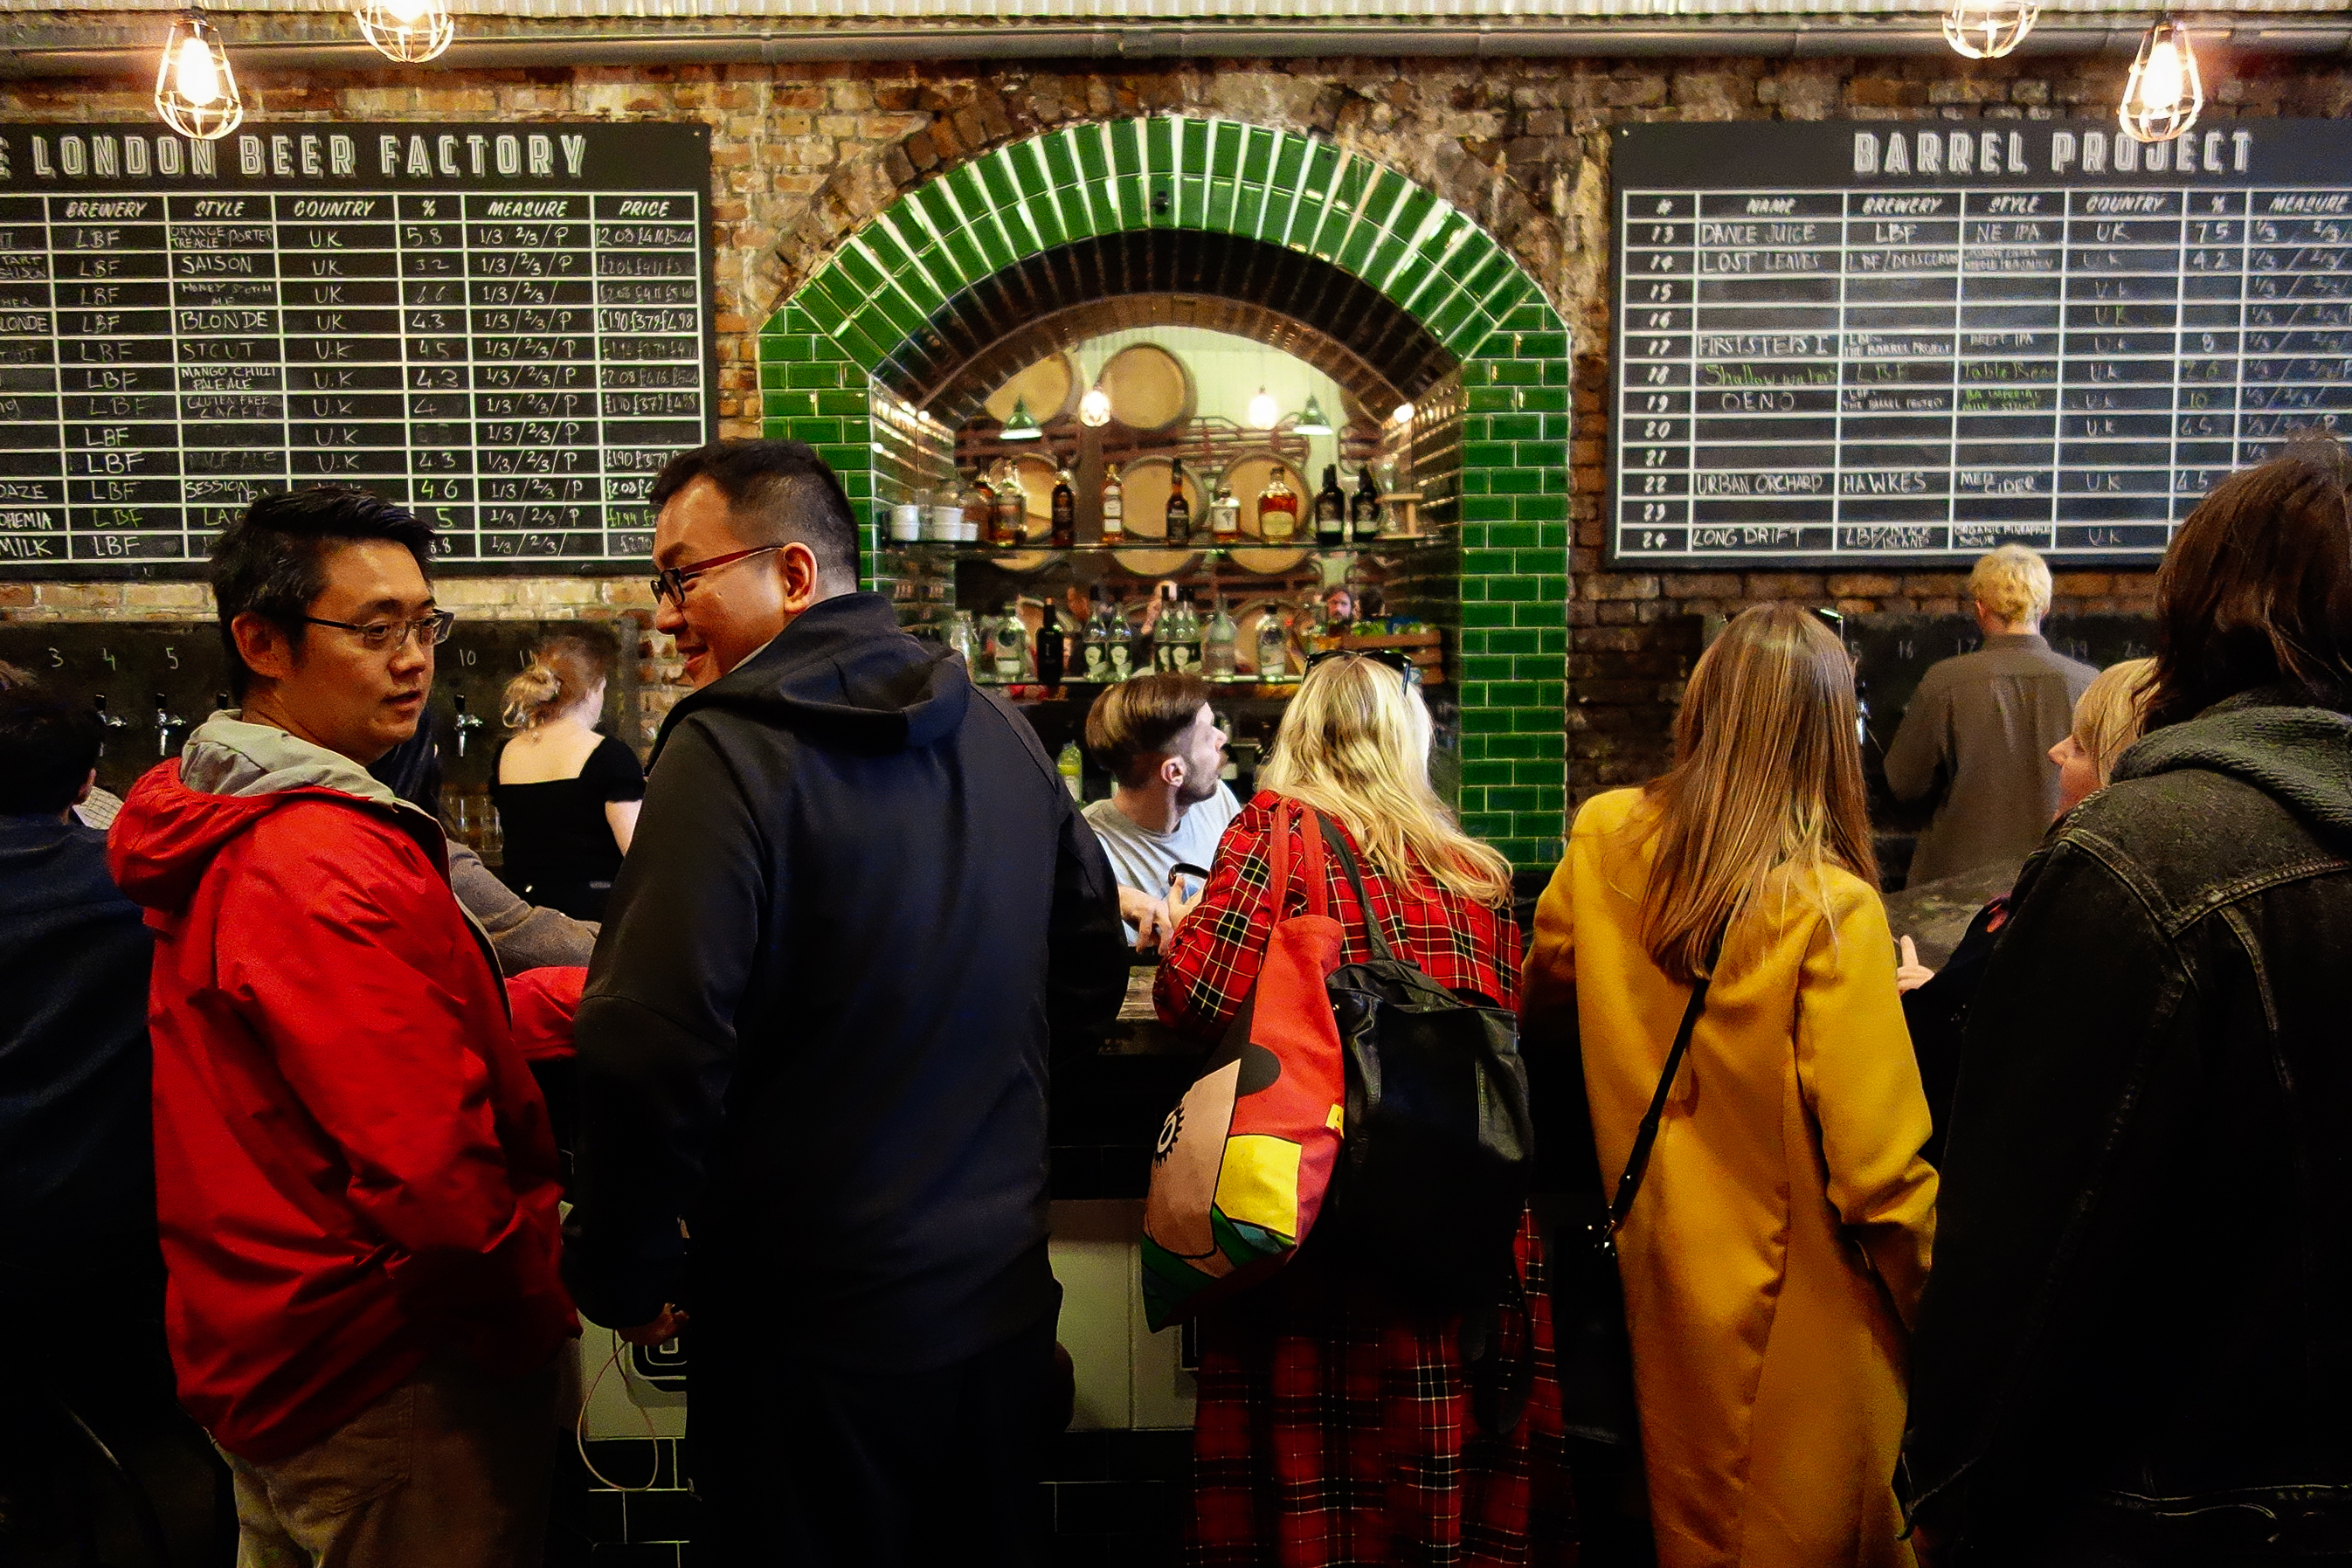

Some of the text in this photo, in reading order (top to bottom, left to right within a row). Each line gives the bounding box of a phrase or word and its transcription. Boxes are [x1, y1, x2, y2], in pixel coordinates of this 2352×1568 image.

[32, 134, 218, 179] LONDON
[239, 134, 356, 178] BEER
[380, 134, 587, 178] FACTORY
[1854, 130, 2253, 175] BARREL PROJECT
[66, 201, 148, 218] BREWERY
[194, 201, 246, 218] STYLE
[294, 200, 375, 218] COUNTRY
[421, 200, 437, 218] %
[488, 200, 568, 218] MEASURE
[619, 200, 670, 218] PRICE
[1863, 197, 1943, 214] BREWERY
[1989, 196, 2041, 214] STYLE
[2086, 195, 2166, 213] COUNTRY
[2269, 195, 2349, 213] MEASURE
[77, 229, 121, 249] LBF
[555, 227, 569, 245] P
[1650, 224, 1675, 245] 13
[1701, 224, 1816, 245] DANCE JUICE
[1875, 223, 1918, 245] LBF
[2097, 222, 2131, 242] UK
[170, 238, 218, 249] TREACLE
[80, 260, 121, 277] LBF
[181, 255, 252, 274] SAISON
[559, 255, 573, 273] P
[1702, 252, 1758, 273] LOST
[81, 287, 121, 306] LBF
[1650, 282, 1674, 302] 15
[82, 315, 121, 333] LBF
[181, 311, 268, 331] BLONDE
[317, 314, 348, 331] UK
[558, 311, 572, 332] P
[1649, 311, 1672, 329] 16
[81, 342, 134, 363] LBF
[562, 339, 576, 358] P
[87, 370, 139, 391] LBF
[181, 366, 228, 378] MANGO
[565, 367, 577, 384] P
[1648, 365, 1670, 384] 18
[90, 396, 150, 417] LBF
[564, 394, 578, 418] P
[1647, 394, 1669, 412] 19
[85, 427, 129, 446] LBF
[564, 422, 579, 446] P
[1644, 420, 1671, 439] 20
[87, 452, 145, 473] LBF
[564, 452, 578, 471] P
[1645, 449, 1667, 466] 21
[92, 480, 142, 501] LBF
[185, 480, 250, 499] SESSION
[573, 480, 583, 499] P
[1644, 475, 1667, 494] 22
[1697, 473, 1823, 495] URBAN ORCHARD
[1844, 472, 1927, 494] HAWKES
[93, 507, 143, 528] LBF
[436, 508, 454, 528] 5
[570, 508, 580, 528] P
[1643, 502, 1666, 522] 23
[93, 535, 141, 556] LBF
[1692, 528, 1801, 549] LONG DRIFT
[48, 646, 65, 668] 3
[101, 646, 116, 672] 4
[165, 646, 179, 670] 5
[459, 648, 477, 667] 10
